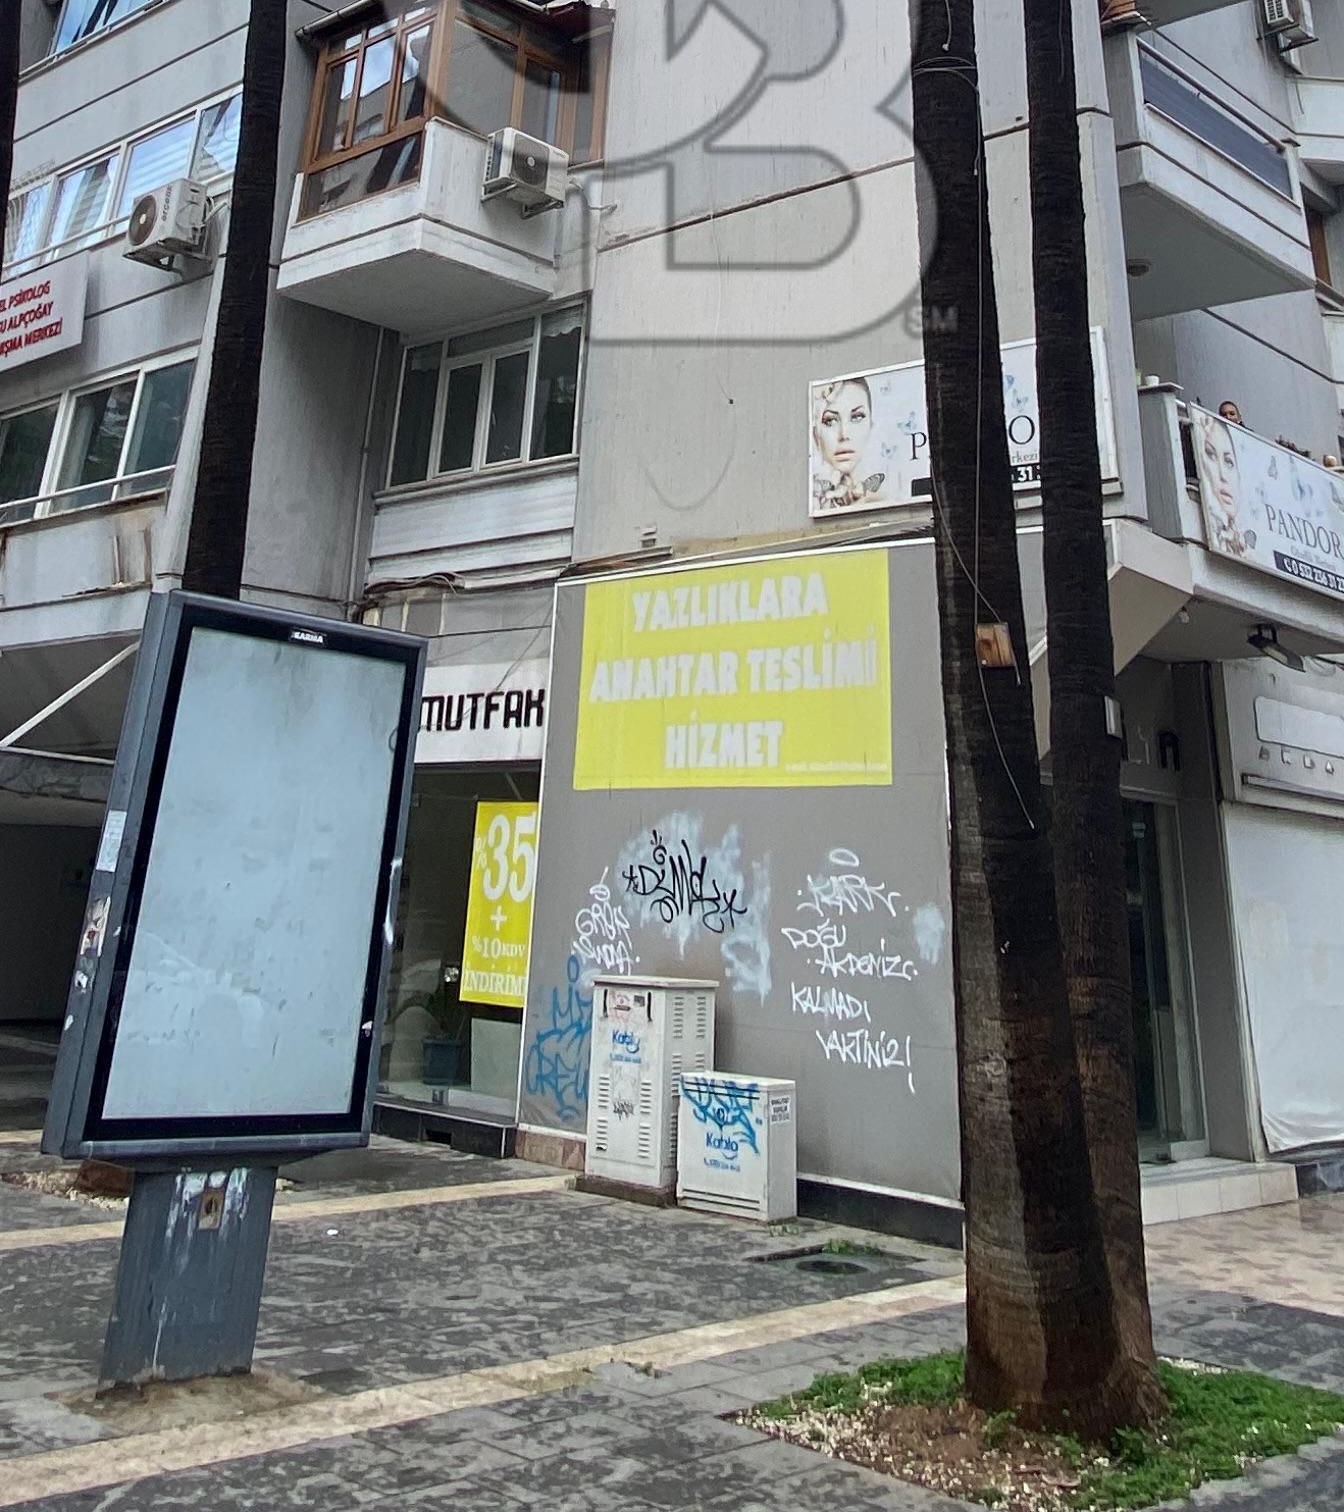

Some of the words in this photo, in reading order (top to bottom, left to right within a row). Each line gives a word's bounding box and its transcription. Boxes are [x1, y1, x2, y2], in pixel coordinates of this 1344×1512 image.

[632, 572, 829, 633] YAZLIKLARA
[588, 651, 738, 703] ANAHTAR
[746, 623, 878, 693] TESLİMİ
[419, 688, 545, 732] MUTFAK
[664, 710, 784, 769] HİZMET
